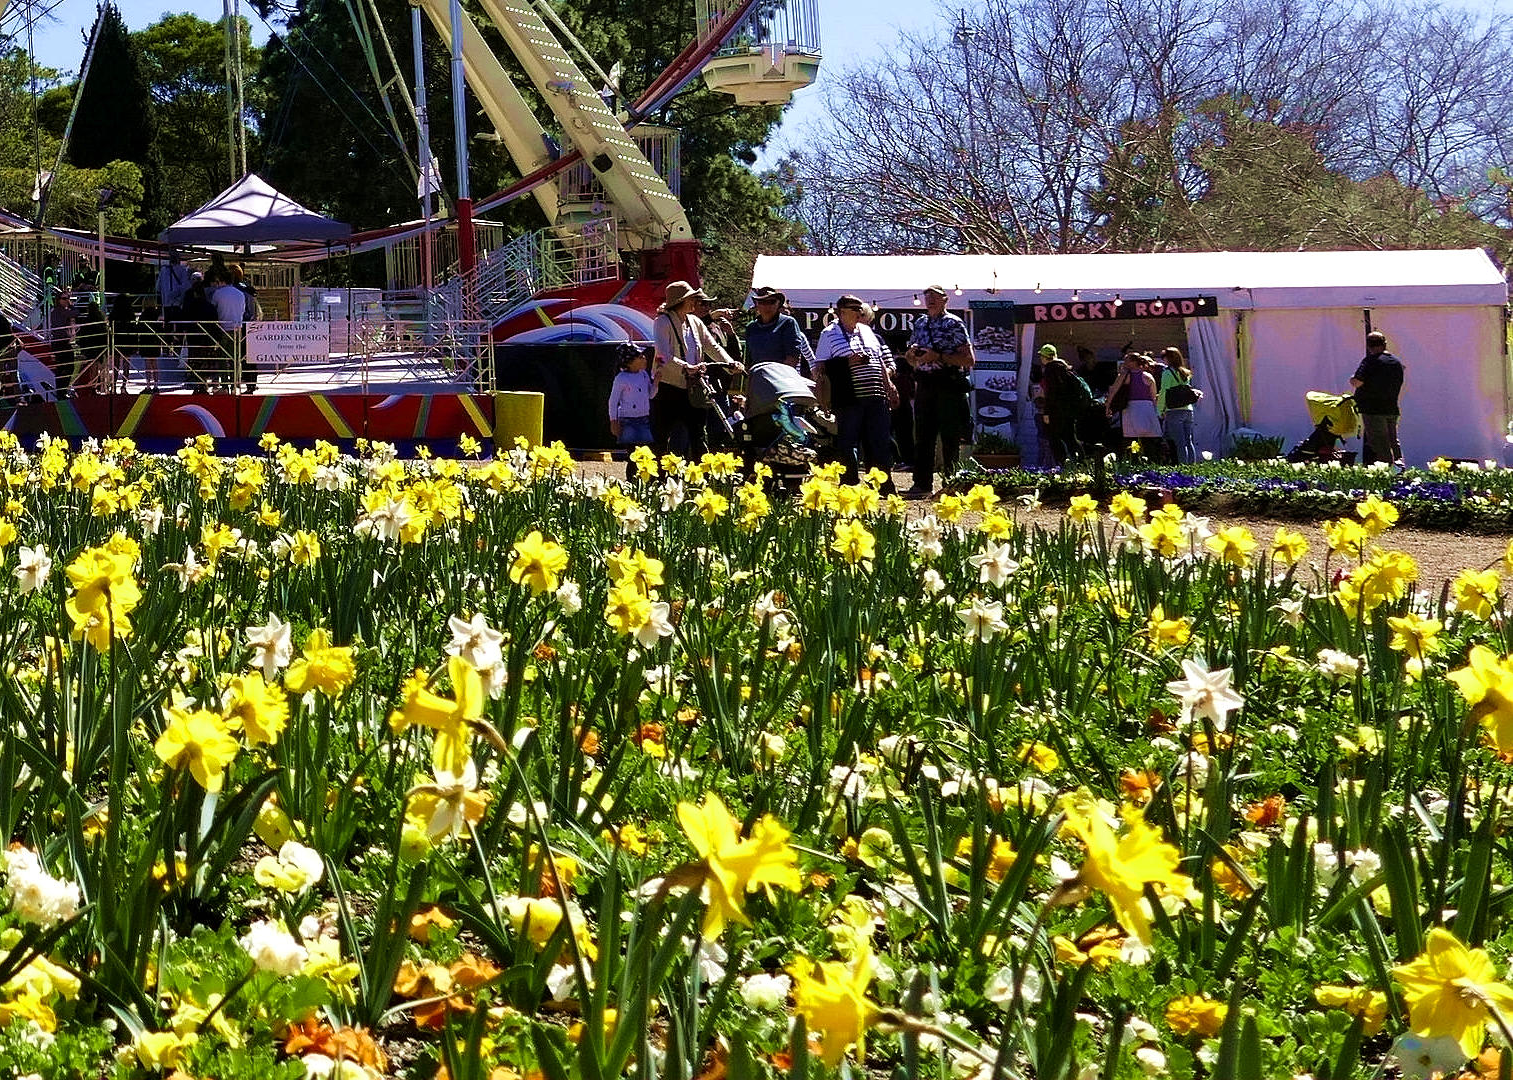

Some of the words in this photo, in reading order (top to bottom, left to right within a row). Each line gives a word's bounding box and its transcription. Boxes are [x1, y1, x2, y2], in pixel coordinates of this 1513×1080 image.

[805, 311, 915, 331] POOR
[1034, 302, 1118, 321] ROCKY
[1136, 301, 1195, 317] ROAD
[256, 354, 289, 363] GIANT
[292, 354, 327, 363] WHEEL
